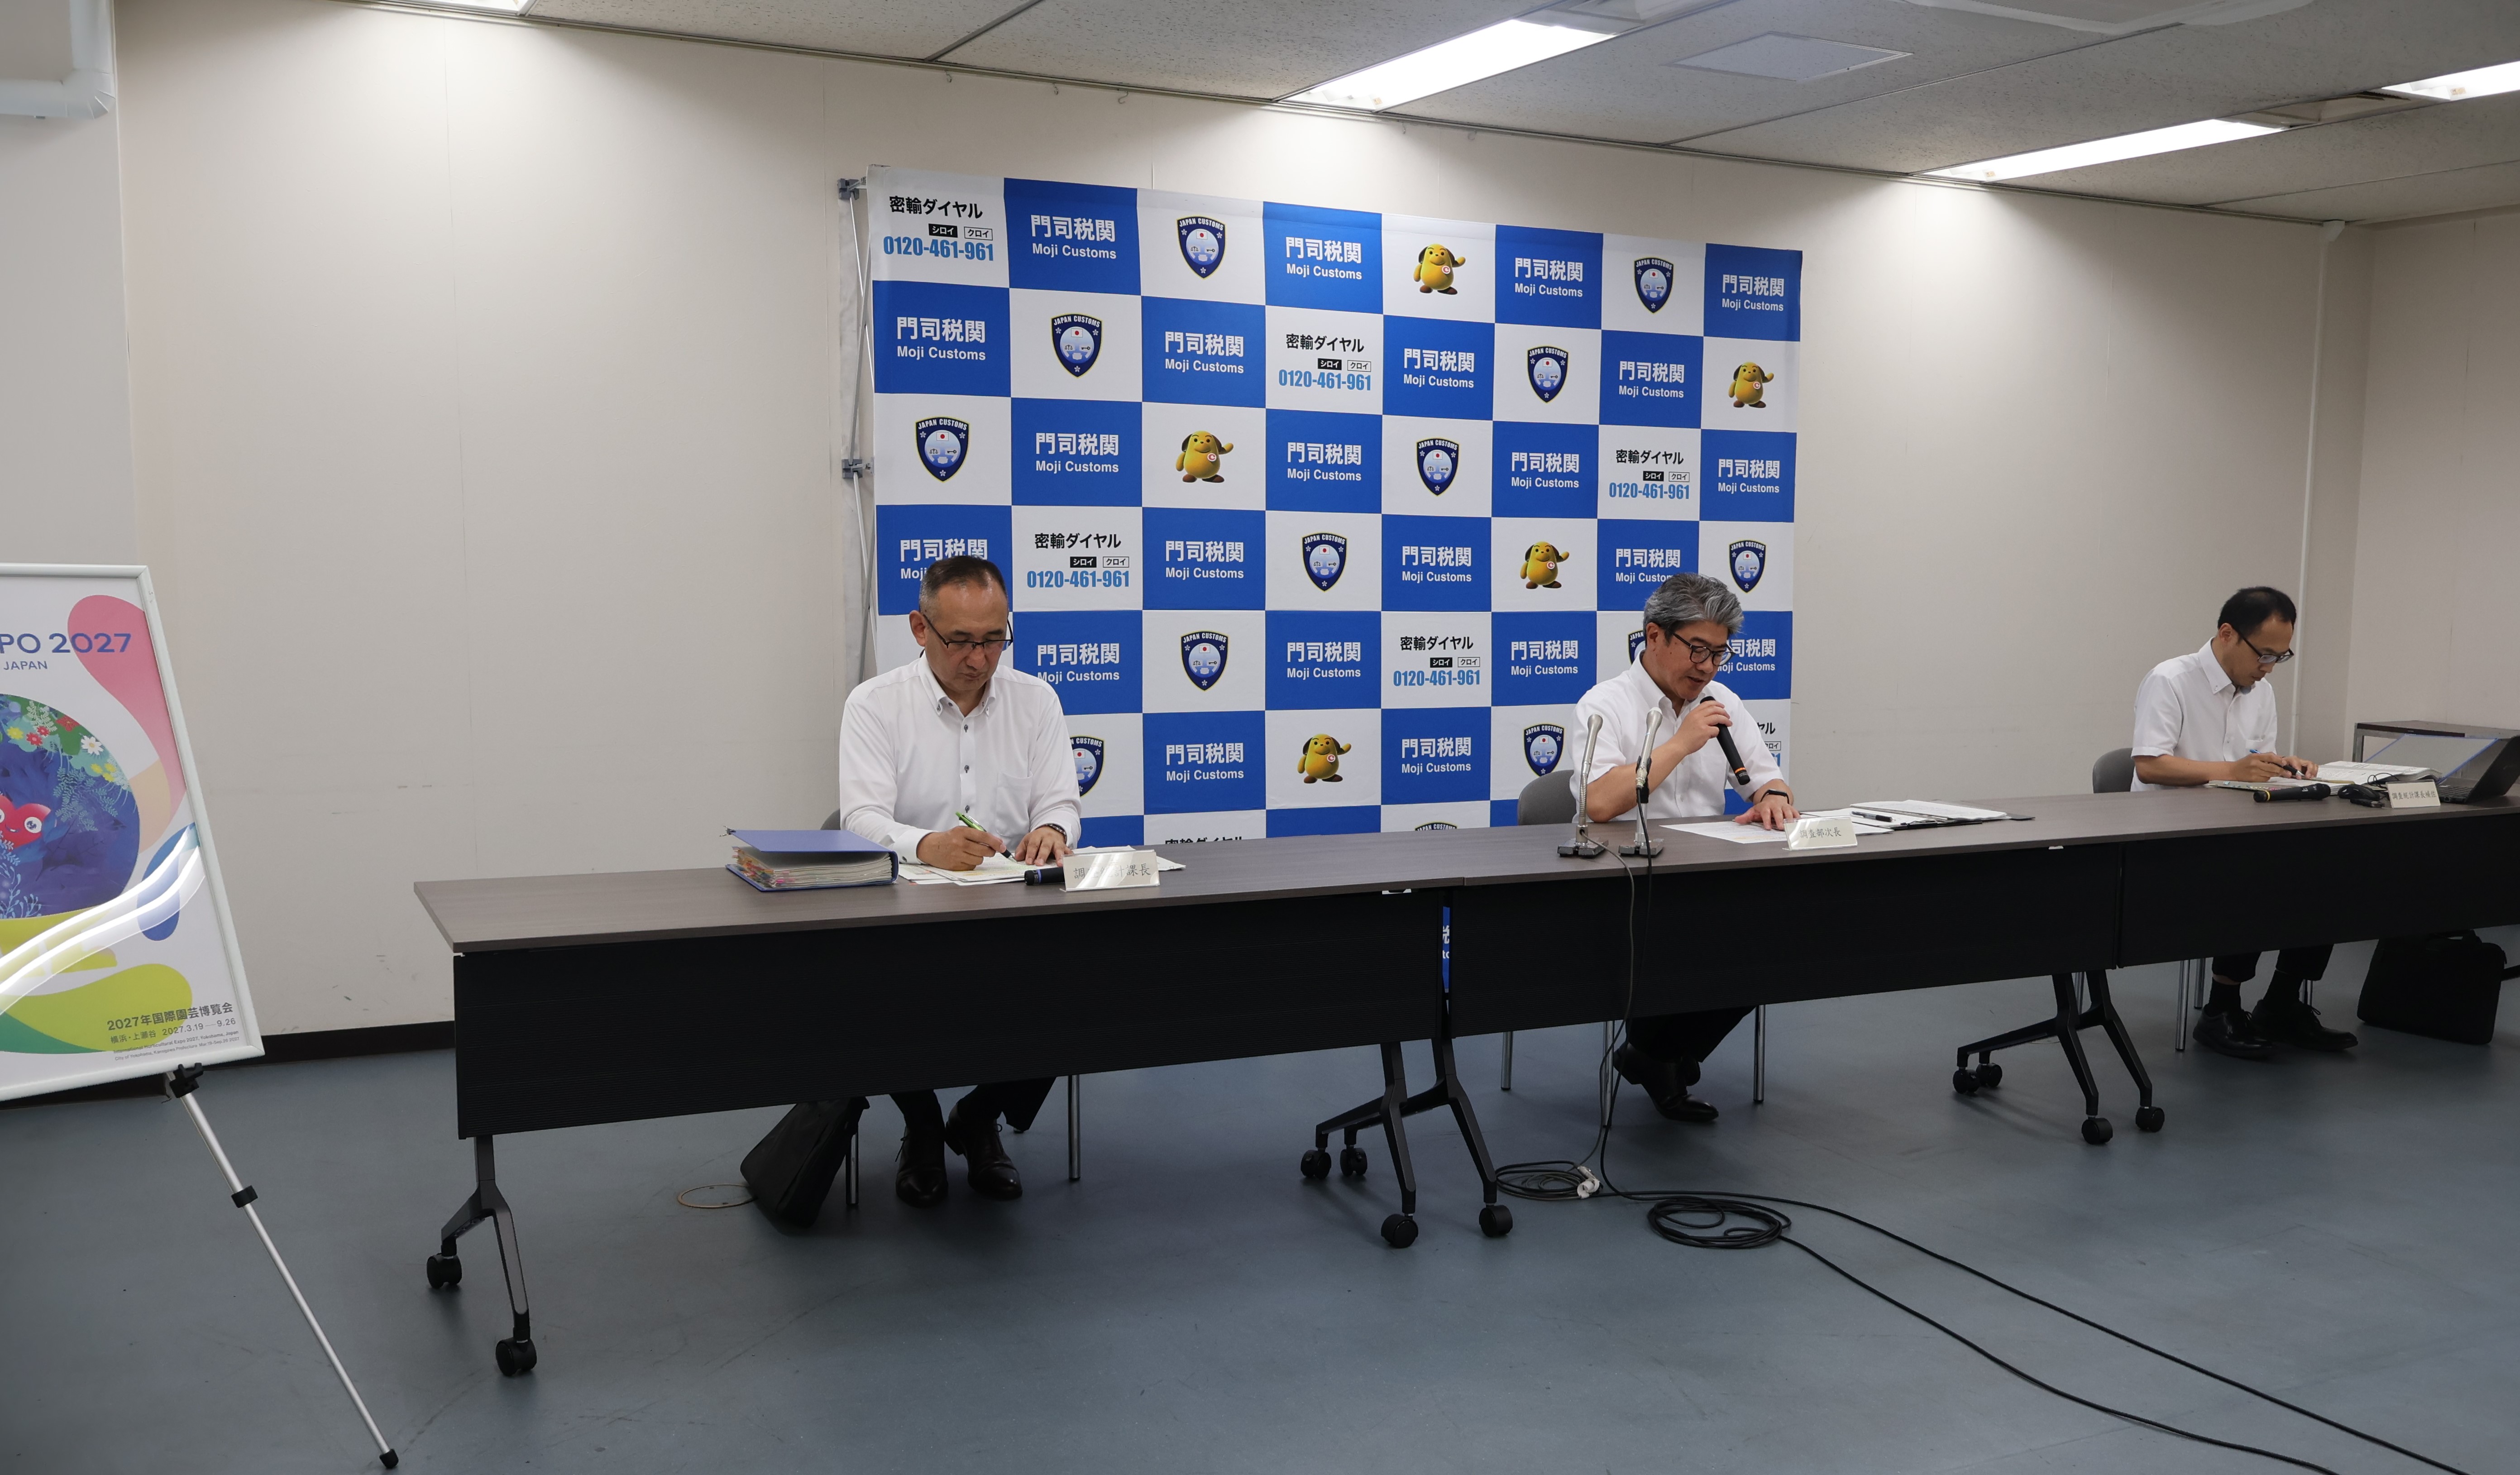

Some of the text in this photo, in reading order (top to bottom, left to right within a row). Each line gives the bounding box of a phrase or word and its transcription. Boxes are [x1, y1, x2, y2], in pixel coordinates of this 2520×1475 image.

[889, 196, 982, 219] 密輸ダイヤル
[1031, 215, 1115, 242] 門司税関
[1179, 217, 1224, 231] JAPAN CUSTOMS
[932, 226, 989, 238] シロイ クロイ
[884, 236, 993, 261] 0120-461-961
[1033, 243, 1116, 259] Moji Customs
[1286, 237, 1361, 263] 門司税関
[1287, 263, 1362, 279] Moji Customs
[1516, 258, 1583, 282] 門司税関
[1652, 259, 1672, 270] CUSTOMS
[1515, 283, 1583, 297] Moji Customs
[1723, 275, 1784, 297] 門司税関
[1722, 298, 1783, 311] Moji Customs
[1054, 316, 1100, 327] JAPAN CUSTOMS
[898, 317, 985, 343] 門司税関
[1166, 332, 1243, 357] 門司税関
[1286, 334, 1364, 352] 密輸ダイヤル
[898, 346, 985, 360] Moji Customs
[1530, 348, 1567, 358] JAPAN CUSTOMS
[1166, 359, 1243, 373] Moji Customs
[1404, 349, 1474, 372] 門司税関
[1620, 361, 1684, 383] 門司税関
[1279, 369, 1370, 390] 0120-461-961
[1404, 374, 1473, 388] Moji Customs
[1619, 385, 1683, 397] Moji Customs
[918, 419, 967, 430] JAPAN CUSTOMS
[1036, 433, 1118, 455] 門司税関
[1419, 440, 1457, 450] JAPAN CUSTOMS
[1288, 442, 1361, 465] 門司税関
[1616, 450, 1683, 465] 密輸ダイヤル
[1036, 461, 1119, 474] Moji Customs
[1512, 452, 1579, 473] 門司税関
[1719, 459, 1779, 479] 門司税関
[1288, 469, 1361, 481] Moji Customs
[1512, 477, 1579, 489] Moji Customs
[1718, 483, 1779, 494] Moji Customs
[1609, 483, 1689, 499] 0120-461-961
[1035, 533, 1121, 549] 密輸ダイヤル
[1305, 535, 1345, 544] JAPAN CUSTOMS
[1745, 541, 1764, 551] CUSTOMS
[901, 539, 987, 561] 門司税関
[1166, 541, 1243, 562] 門司税関
[1403, 546, 1471, 566] 門司税関
[1616, 549, 1680, 567] 門司税関
[1028, 570, 1129, 588] 0120-461-961
[1166, 568, 1243, 580] Moji Customs
[1402, 571, 1472, 583] Moji Customs
[1616, 573, 1673, 584] Moji Custo
[49, 633, 131, 653] 2027
[1184, 633, 1226, 643] JAPAN CUSTOMS
[1401, 636, 1473, 650] 密輸ダイヤル
[1630, 632, 1644, 640] JAPAN
[1038, 643, 1119, 666] 門司税関
[1288, 642, 1360, 662] 門司税関
[1511, 641, 1578, 660] 門司税関
[1726, 639, 1775, 657] 司税関
[4, 661, 48, 670] JAPAN
[1511, 665, 1578, 677] Moji Customs
[1736, 662, 1775, 671] Customs
[1038, 671, 1119, 685] Moji Customs
[1287, 668, 1361, 680] Moji Customs
[1394, 670, 1479, 686] 0120-461-961
[1526, 725, 1563, 735] JAPAN CUSTOMS
[1076, 738, 1102, 747] CUSTOMS
[1402, 738, 1471, 758] 門司税関
[1167, 743, 1243, 765] 門司税関
[1402, 763, 1471, 775] Moji Customs
[1167, 770, 1243, 783] Moji Customs
[1800, 827, 1841, 839] 調査部次長
[107, 1002, 233, 1031] 2027年国際園芸博覧会
